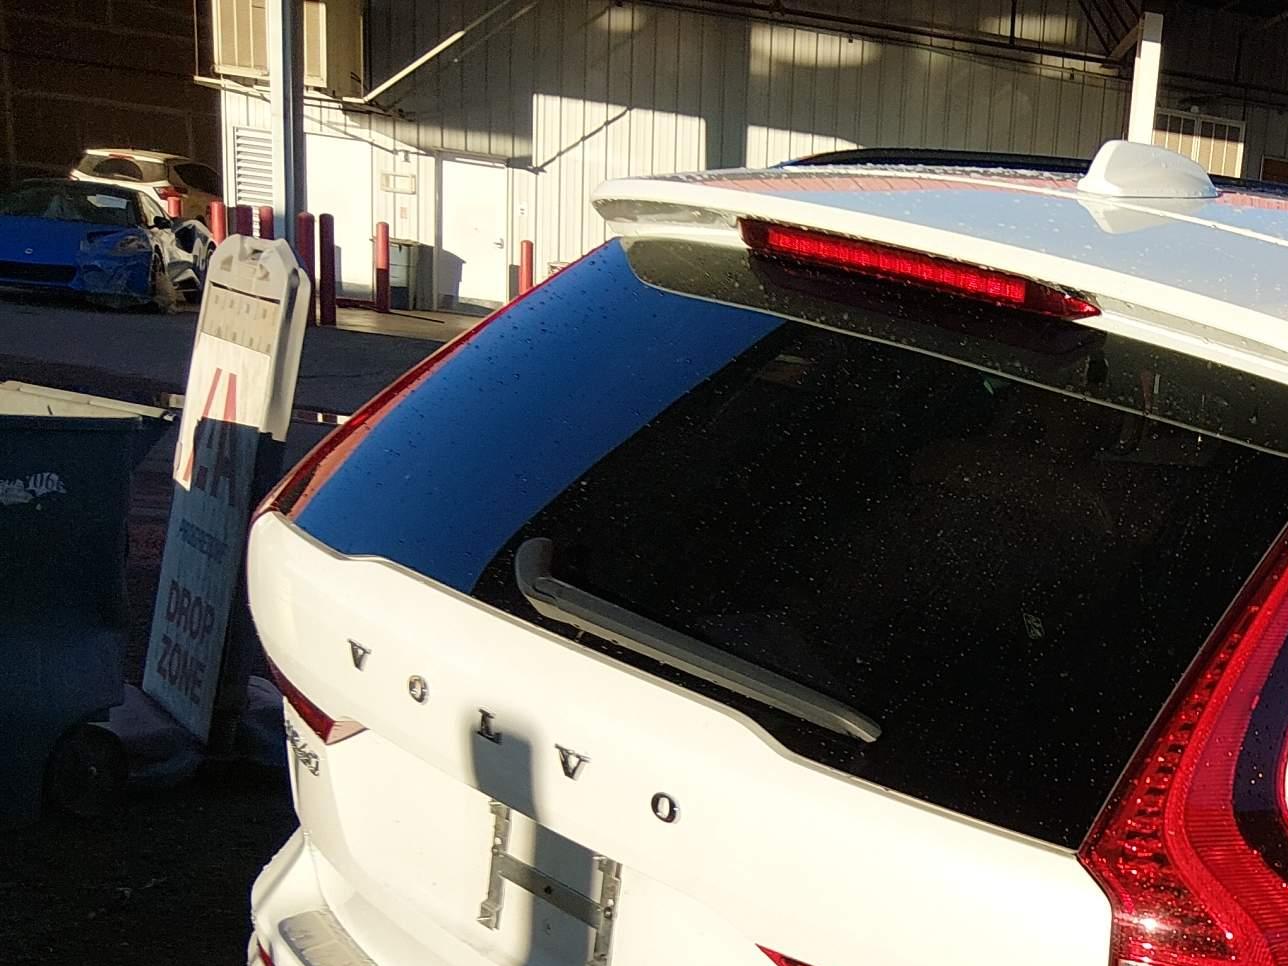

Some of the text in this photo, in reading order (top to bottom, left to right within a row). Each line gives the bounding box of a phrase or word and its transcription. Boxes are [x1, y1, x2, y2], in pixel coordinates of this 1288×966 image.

[166, 579, 215, 641] DROP
[157, 633, 207, 704] ZONE
[347, 638, 681, 824] VOLVO
